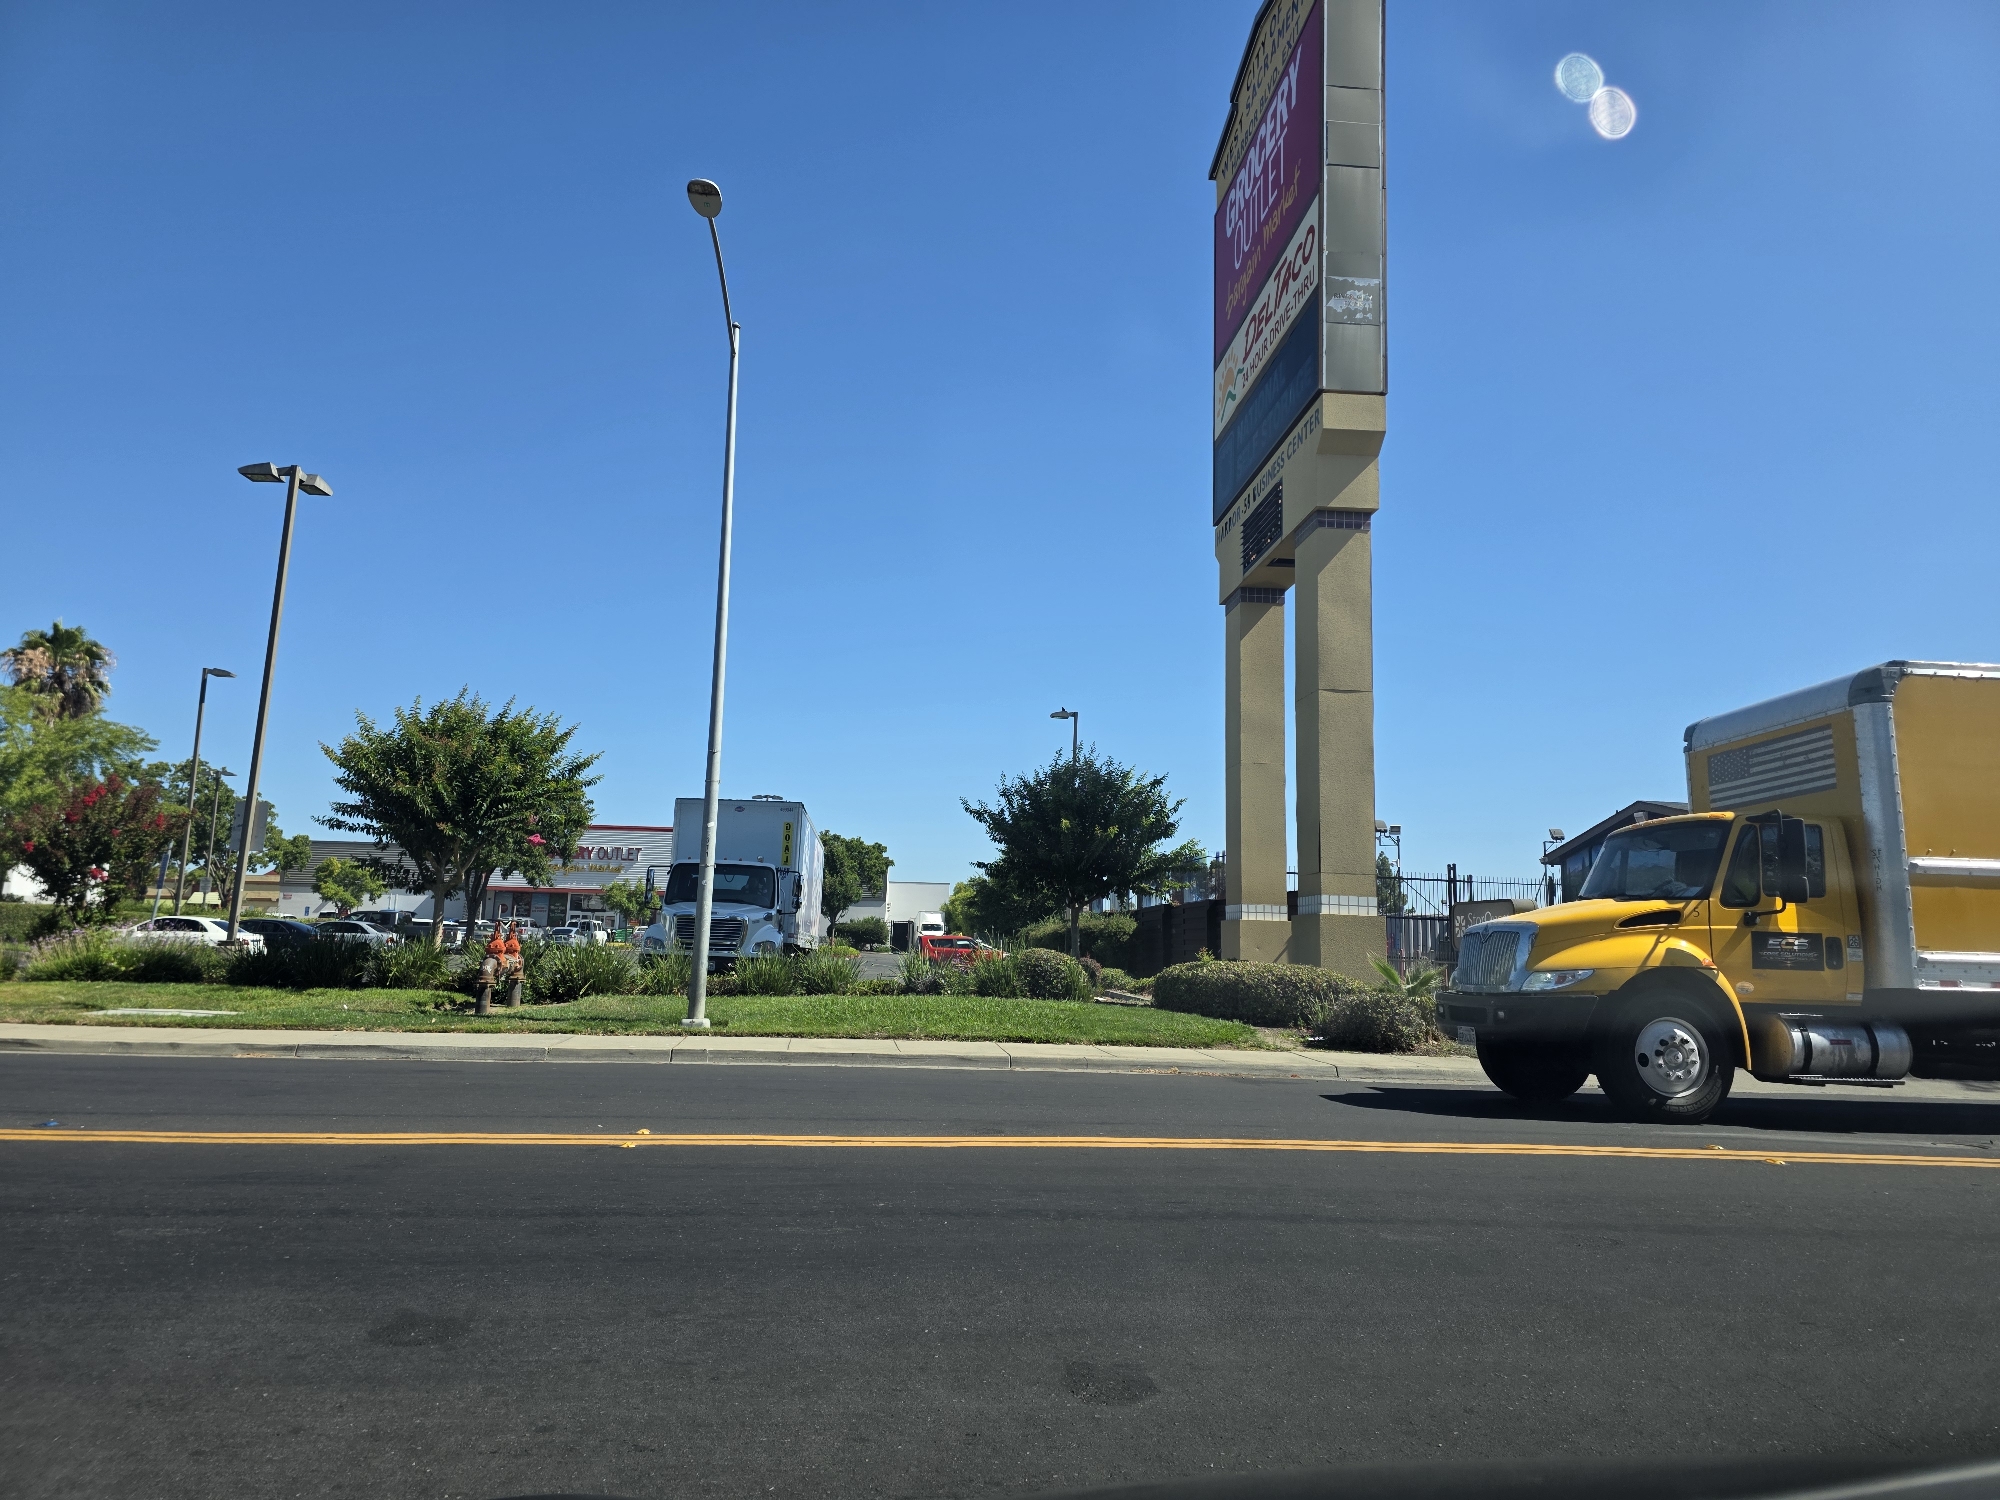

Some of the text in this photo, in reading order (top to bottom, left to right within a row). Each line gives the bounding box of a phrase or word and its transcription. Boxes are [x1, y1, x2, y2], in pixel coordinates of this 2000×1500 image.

[1222, 0, 1304, 179] WEST SACRAMEN
[1232, 109, 1258, 175] HARBOR
[1282, 15, 1301, 66] EXIT
[1246, 0, 1282, 92] CITY OF
[1226, 43, 1302, 238] GROCERY
[1234, 126, 1288, 270] OUTLET
[1226, 244, 1261, 321] bargain
[1242, 225, 1316, 365] DEL TACO
[1242, 265, 1315, 389] 24 HOUR DRIVE-THRU
[1236, 358, 1286, 450] NATIONAL
[1253, 450, 1285, 503] BUSINESS
[1286, 407, 1320, 460] CENTER
[597, 846, 643, 861] OUTLET
